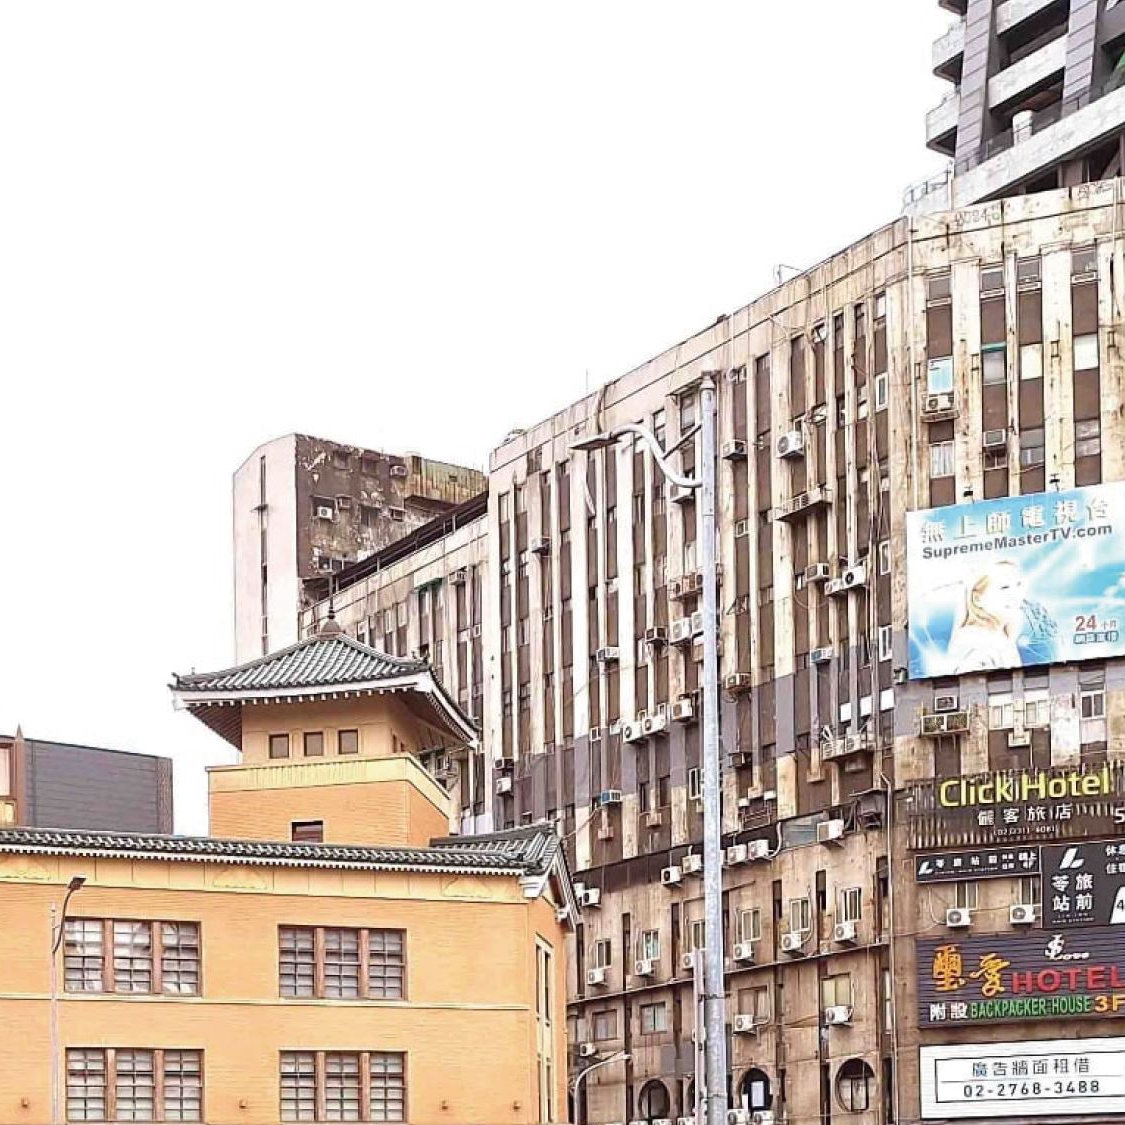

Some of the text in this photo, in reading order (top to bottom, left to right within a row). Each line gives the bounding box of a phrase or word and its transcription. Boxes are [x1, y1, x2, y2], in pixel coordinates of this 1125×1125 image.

[923, 525, 1112, 559] SupremeMasterTV.com
[1075, 615, 1097, 631] 24
[940, 768, 1110, 807] Click Hotel
[1011, 965, 1125, 994] HOTEL
[971, 998, 1047, 1018] BACKPACKER
[1051, 995, 1092, 1013] HOUSE
[963, 1080, 1100, 1098] 02-2768-3488
